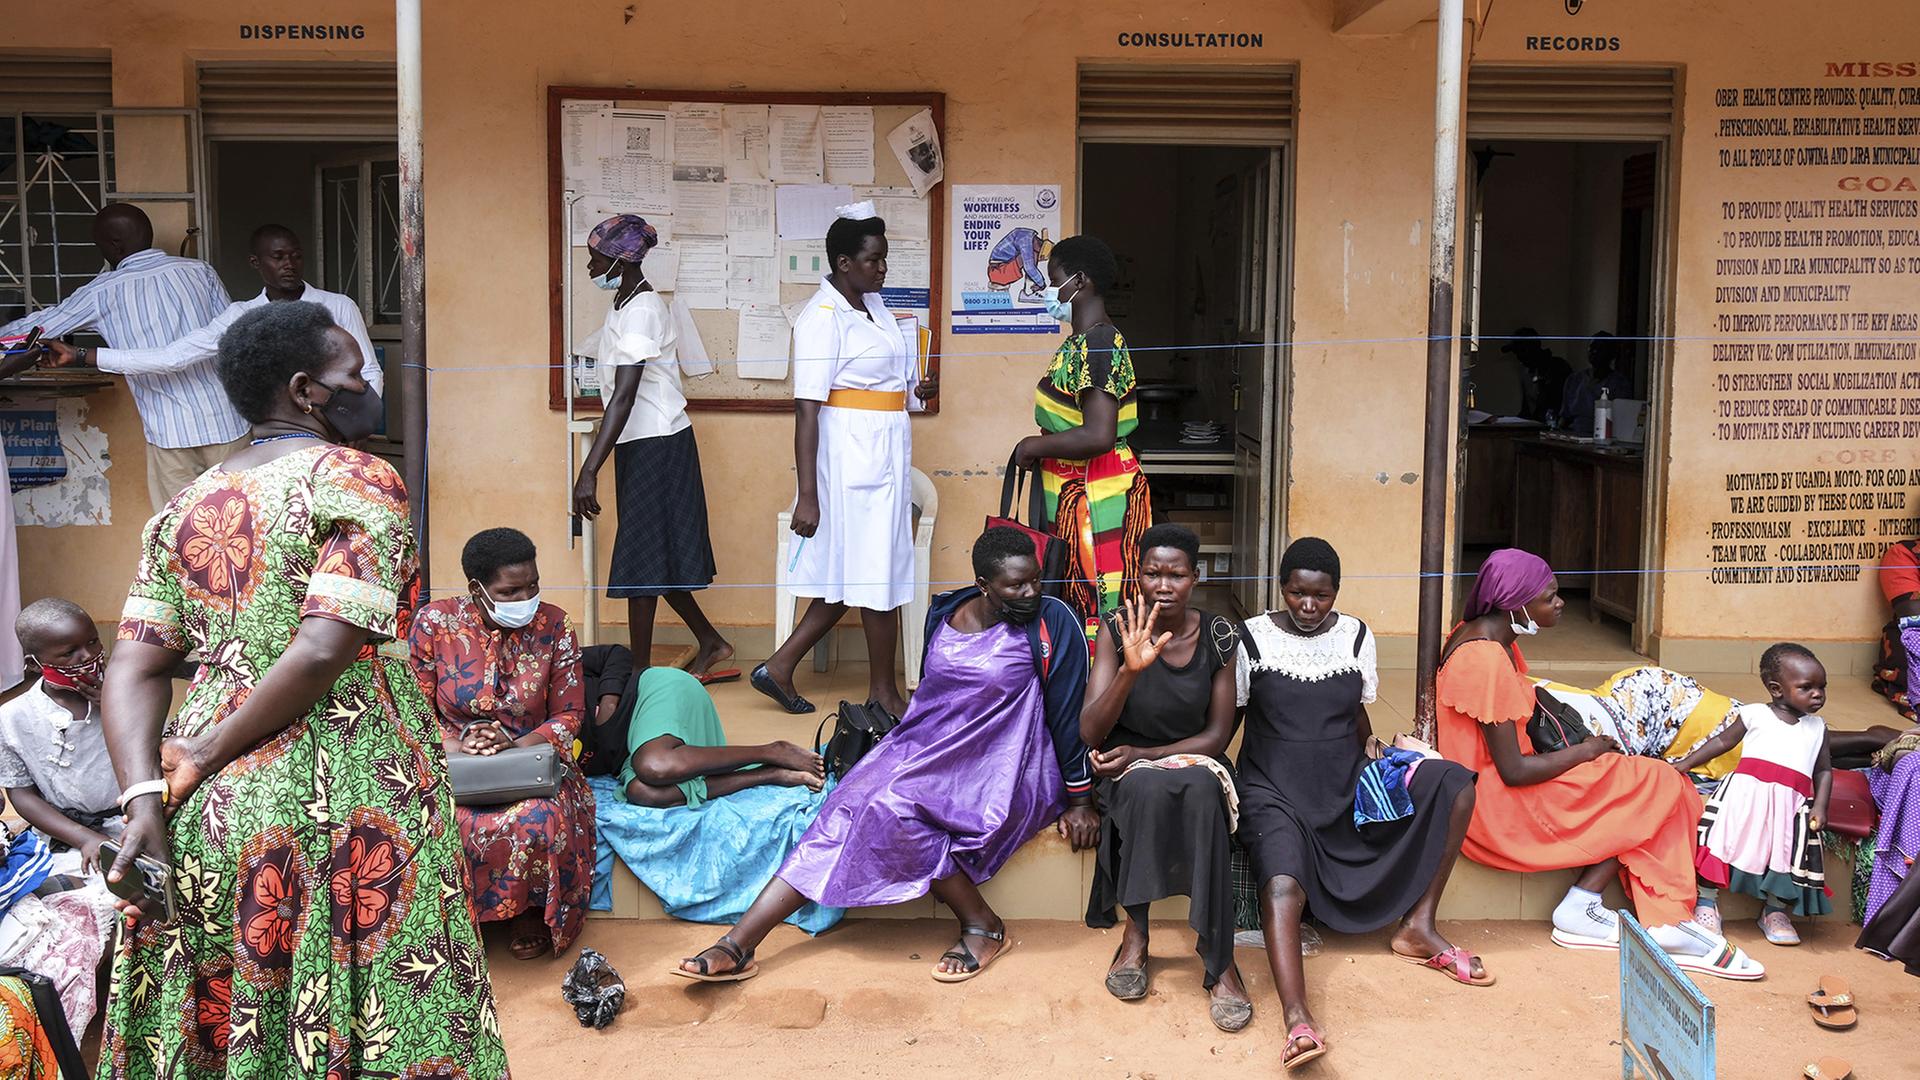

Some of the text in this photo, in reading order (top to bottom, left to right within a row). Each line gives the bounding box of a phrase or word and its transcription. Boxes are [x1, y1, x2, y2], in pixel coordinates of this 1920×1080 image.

[240, 25, 364, 39] DISPENSING
[1118, 33, 1262, 47] CONSULTATION
[1527, 37, 1619, 50] RECORDS
[1825, 63, 1920, 77] MISS
[1716, 89, 1738, 107] OBER
[1743, 88, 1776, 106] HEALTH
[1778, 88, 1811, 106] CENTRE
[1859, 88, 1896, 110] QUALITY,
[1793, 118, 1860, 135] REHABILITATIVE
[1863, 118, 1895, 135] HEALTH
[1720, 149, 1730, 167] TO
[1733, 149, 1747, 167] ALL
[1750, 149, 1781, 166] PEOPLE
[1784, 148, 1795, 166] OF
[1797, 147, 1828, 165] OJWINA
[1831, 147, 1848, 165] AND
[1850, 147, 1870, 164] LIRA
[964, 203, 1019, 212] WORTHLESS
[1722, 200, 1917, 222] TO PROVIDE QUALITY HEALTH SERVICES
[964, 221, 1001, 229] ENDING
[964, 231, 990, 240] YOUR
[1723, 232, 1736, 248] TO
[1739, 231, 1781, 247] PROVIDE
[1784, 230, 1822, 247] HEALTH
[1826, 230, 1884, 249] PROMOTION,
[964, 241, 988, 250] LIFE?
[1717, 257, 1920, 275] DIVISION AND LIRA MUNICIPALITY SO AS TO
[1716, 285, 1850, 303] DIVISION AND MUNICIPALITY
[1719, 313, 1917, 332] TO IMPROVE PERFORMANCE IN THE KEY AREAS
[1713, 344, 1754, 361] DELIVERY
[1757, 344, 1772, 361] VIZ:
[1854, 343, 1916, 360] IMMUNIZATION
[1718, 374, 1730, 392] TO
[1733, 374, 1792, 391] STRENGTHEN
[1798, 373, 1830, 390] SOCIAL
[1833, 372, 1897, 389] MOBILIZATION
[1719, 400, 1731, 417] TO
[1734, 400, 1770, 417] REDUCE
[1773, 399, 1808, 416] SPREAD
[1811, 399, 1823, 416] OF
[1825, 398, 1896, 415] COMMUNICABLE
[1718, 423, 1730, 440] TO
[1733, 423, 1779, 440] MOTIVATE
[1782, 422, 1810, 439] STAFF
[1813, 422, 1861, 439] INCLUDING
[1864, 421, 1899, 438] CAREER
[1817, 450, 1896, 464] CORE
[1727, 473, 1778, 490] MOTIVATED
[1781, 472, 1792, 489] BY
[1796, 471, 1831, 488] UGANDA
[1835, 470, 1862, 491] MOTO:
[1866, 469, 1884, 487] FOR
[1887, 469, 1906, 486] GOD
[1731, 492, 1905, 513] WE ARE GUIDED BY THESE CORE VALUE
[1712, 522, 1791, 539] PROFESSIONALSM
[1808, 520, 1865, 537] EXCELLENCE
[1712, 545, 1736, 562] TEAM
[1740, 545, 1766, 562] WORK
[1780, 543, 1854, 561] COLLABORATION
[1856, 543, 1875, 562] AND
[1712, 565, 1860, 584] COMMITMENT AND STEWARDSHIP
